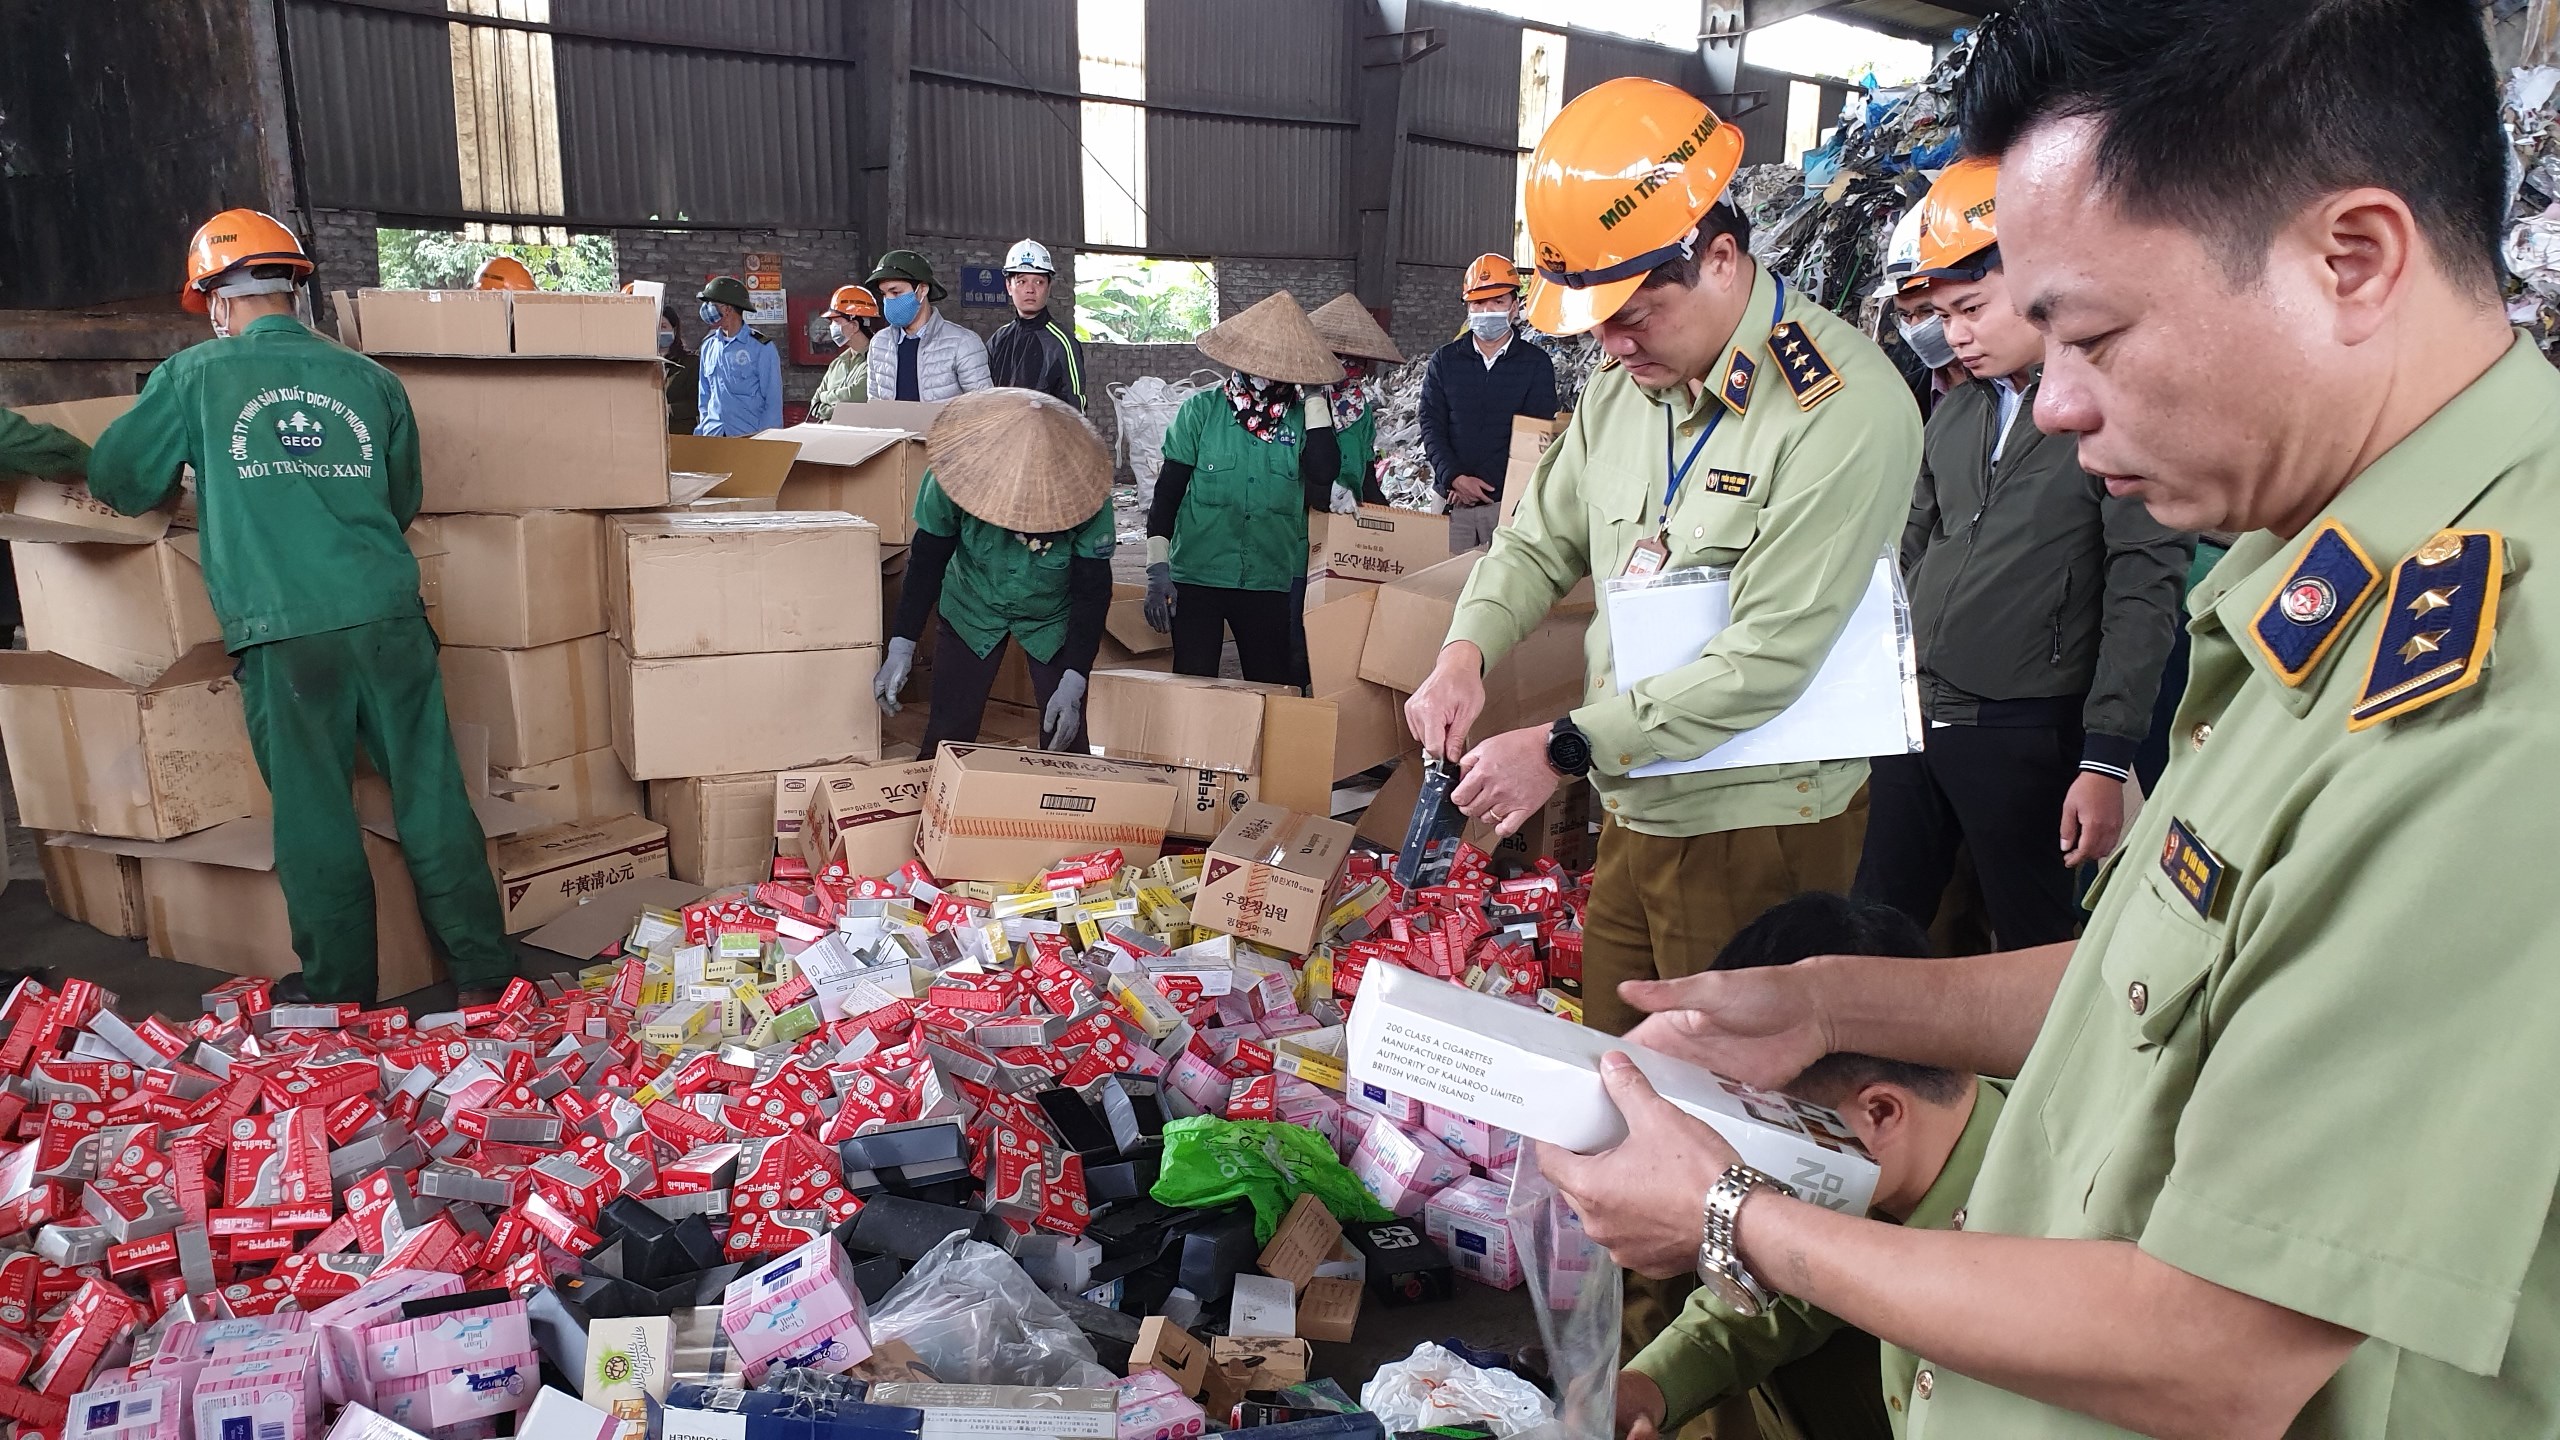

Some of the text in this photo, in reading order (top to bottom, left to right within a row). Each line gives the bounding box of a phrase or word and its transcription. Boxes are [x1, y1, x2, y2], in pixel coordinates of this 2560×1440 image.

[1599, 194, 1637, 231] MÔI
[1691, 112, 1719, 147] XANH
[210, 234, 237, 245] XANH
[257, 387, 279, 406] SẢN
[278, 385, 305, 401] XUẤT
[306, 391, 331, 408] DỊCH
[239, 399, 263, 422] TNHH
[330, 399, 346, 417] VỤ
[233, 421, 249, 434] TY
[228, 435, 248, 461] CÔNG
[281, 435, 322, 447] GECO
[237, 460, 271, 479] MÔI
[332, 464, 372, 479] XANH
[1386, 1022, 1493, 1065] 200 CLASS A CIGARETTES
[1381, 1036, 1486, 1077] MANUFACTURED UNDER
[1372, 1061, 1476, 1103] BRITISH VIRGIN ISLANDS
[1376, 1049, 1525, 1106] AUTHORITY OF KALLAROO LIMITED,
[635, 1325, 655, 1377] Capsule
[628, 1341, 647, 1391] Marula
